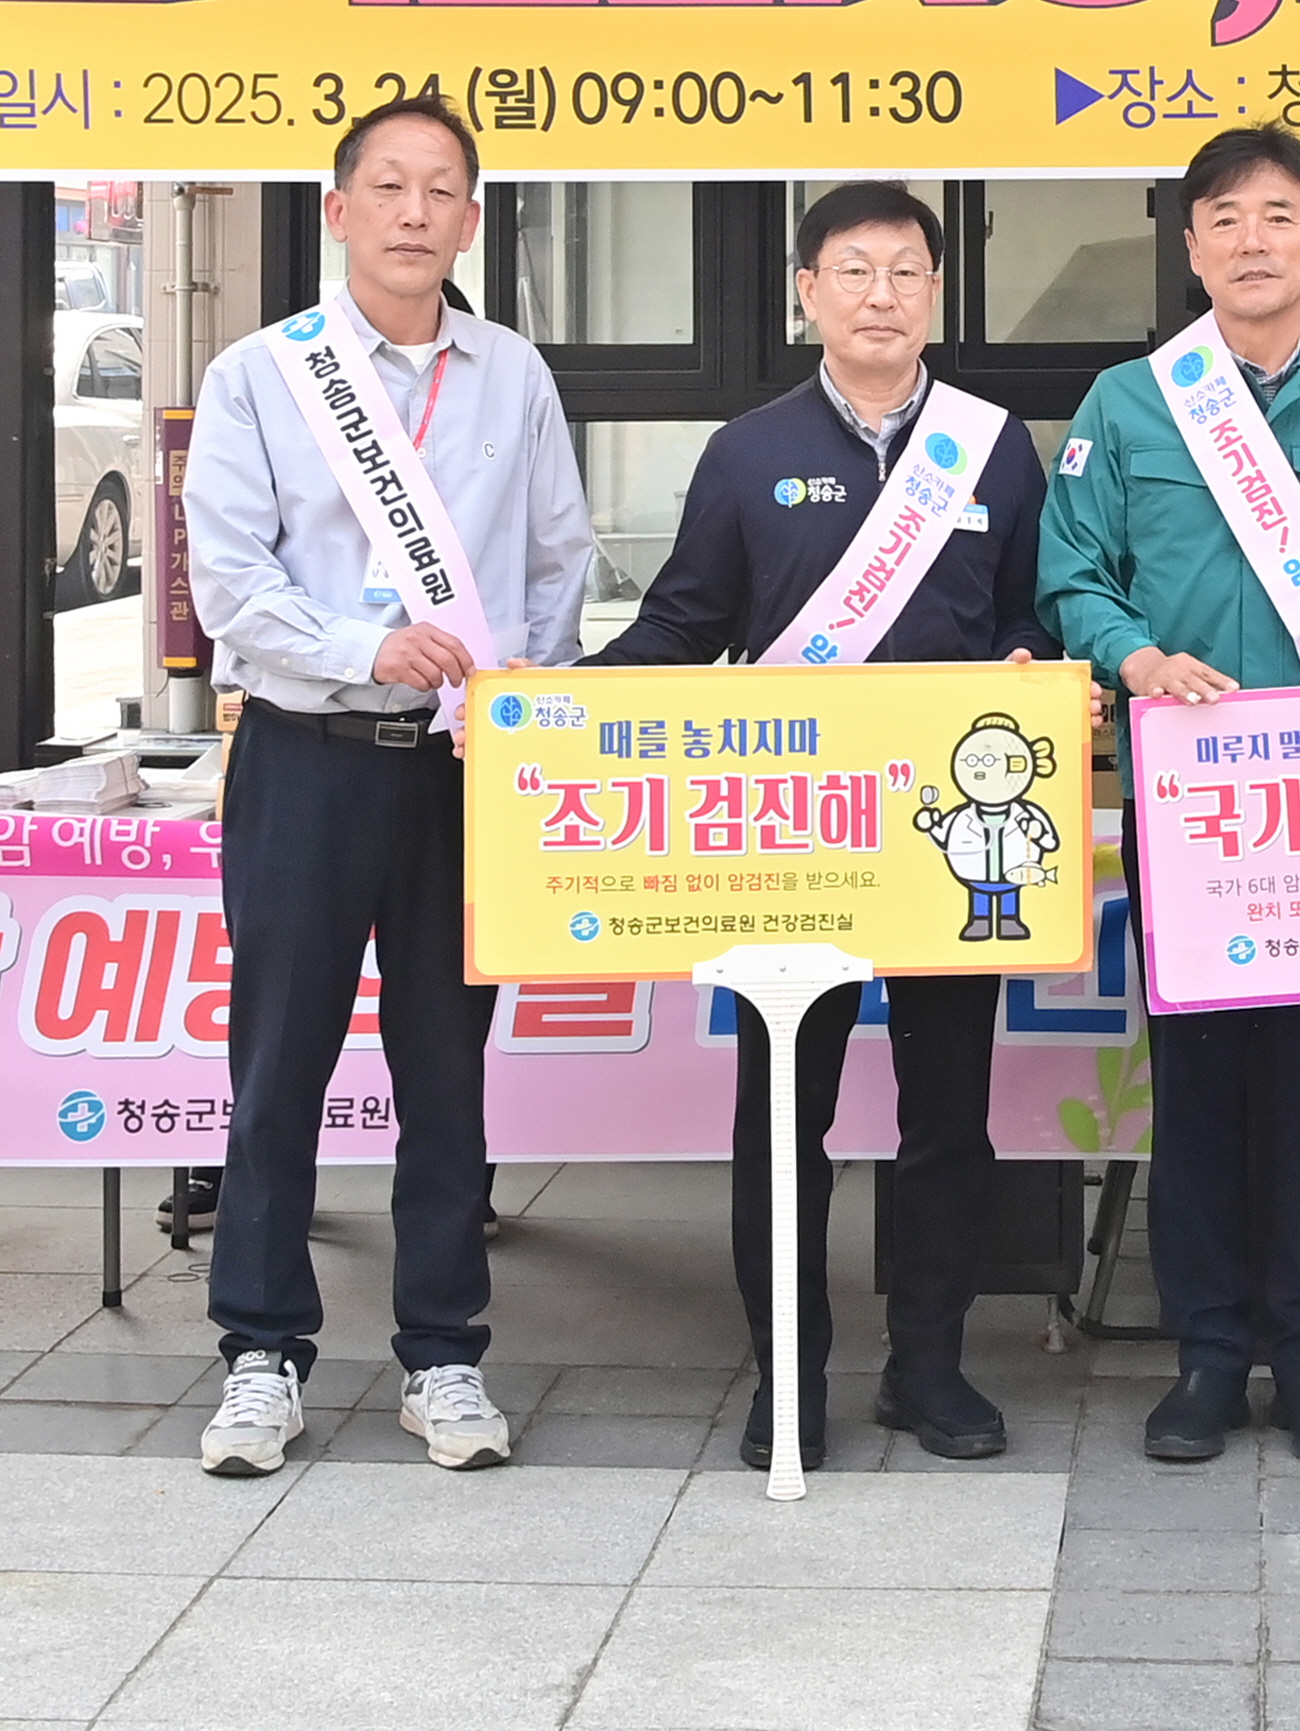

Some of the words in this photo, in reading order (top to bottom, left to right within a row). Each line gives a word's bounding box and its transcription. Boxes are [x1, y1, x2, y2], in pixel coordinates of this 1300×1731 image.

[142, 72, 294, 126] 2025.
[571, 70, 963, 126] 09:00~11:30
[1106, 65, 1219, 129] 장소
[1184, 375, 1227, 408] 산소카페
[1188, 387, 1237, 425] 청송군
[304, 345, 455, 606] 청송군보건의료원
[1209, 417, 1290, 554] 조기검진!
[807, 485, 848, 503] 청송군
[905, 475, 950, 519] 청송군
[827, 504, 926, 631] 조기검진!
[535, 706, 587, 728] 청송군
[599, 719, 668, 759] 때를
[681, 717, 822, 759] 놓치지마
[1196, 732, 1272, 765] 미루지
[545, 876, 636, 894] 주기적으로
[643, 874, 678, 893] 빠짐
[685, 873, 720, 892] 없이
[727, 872, 799, 892] 암검진을
[806, 870, 882, 891] 받으세요.
[1205, 877, 1242, 898] 국가
[1248, 875, 1277, 895] 6대
[608, 914, 756, 936] 청송군보건의료원
[762, 913, 854, 932] 건강검진실
[1246, 901, 1281, 922] 완치
